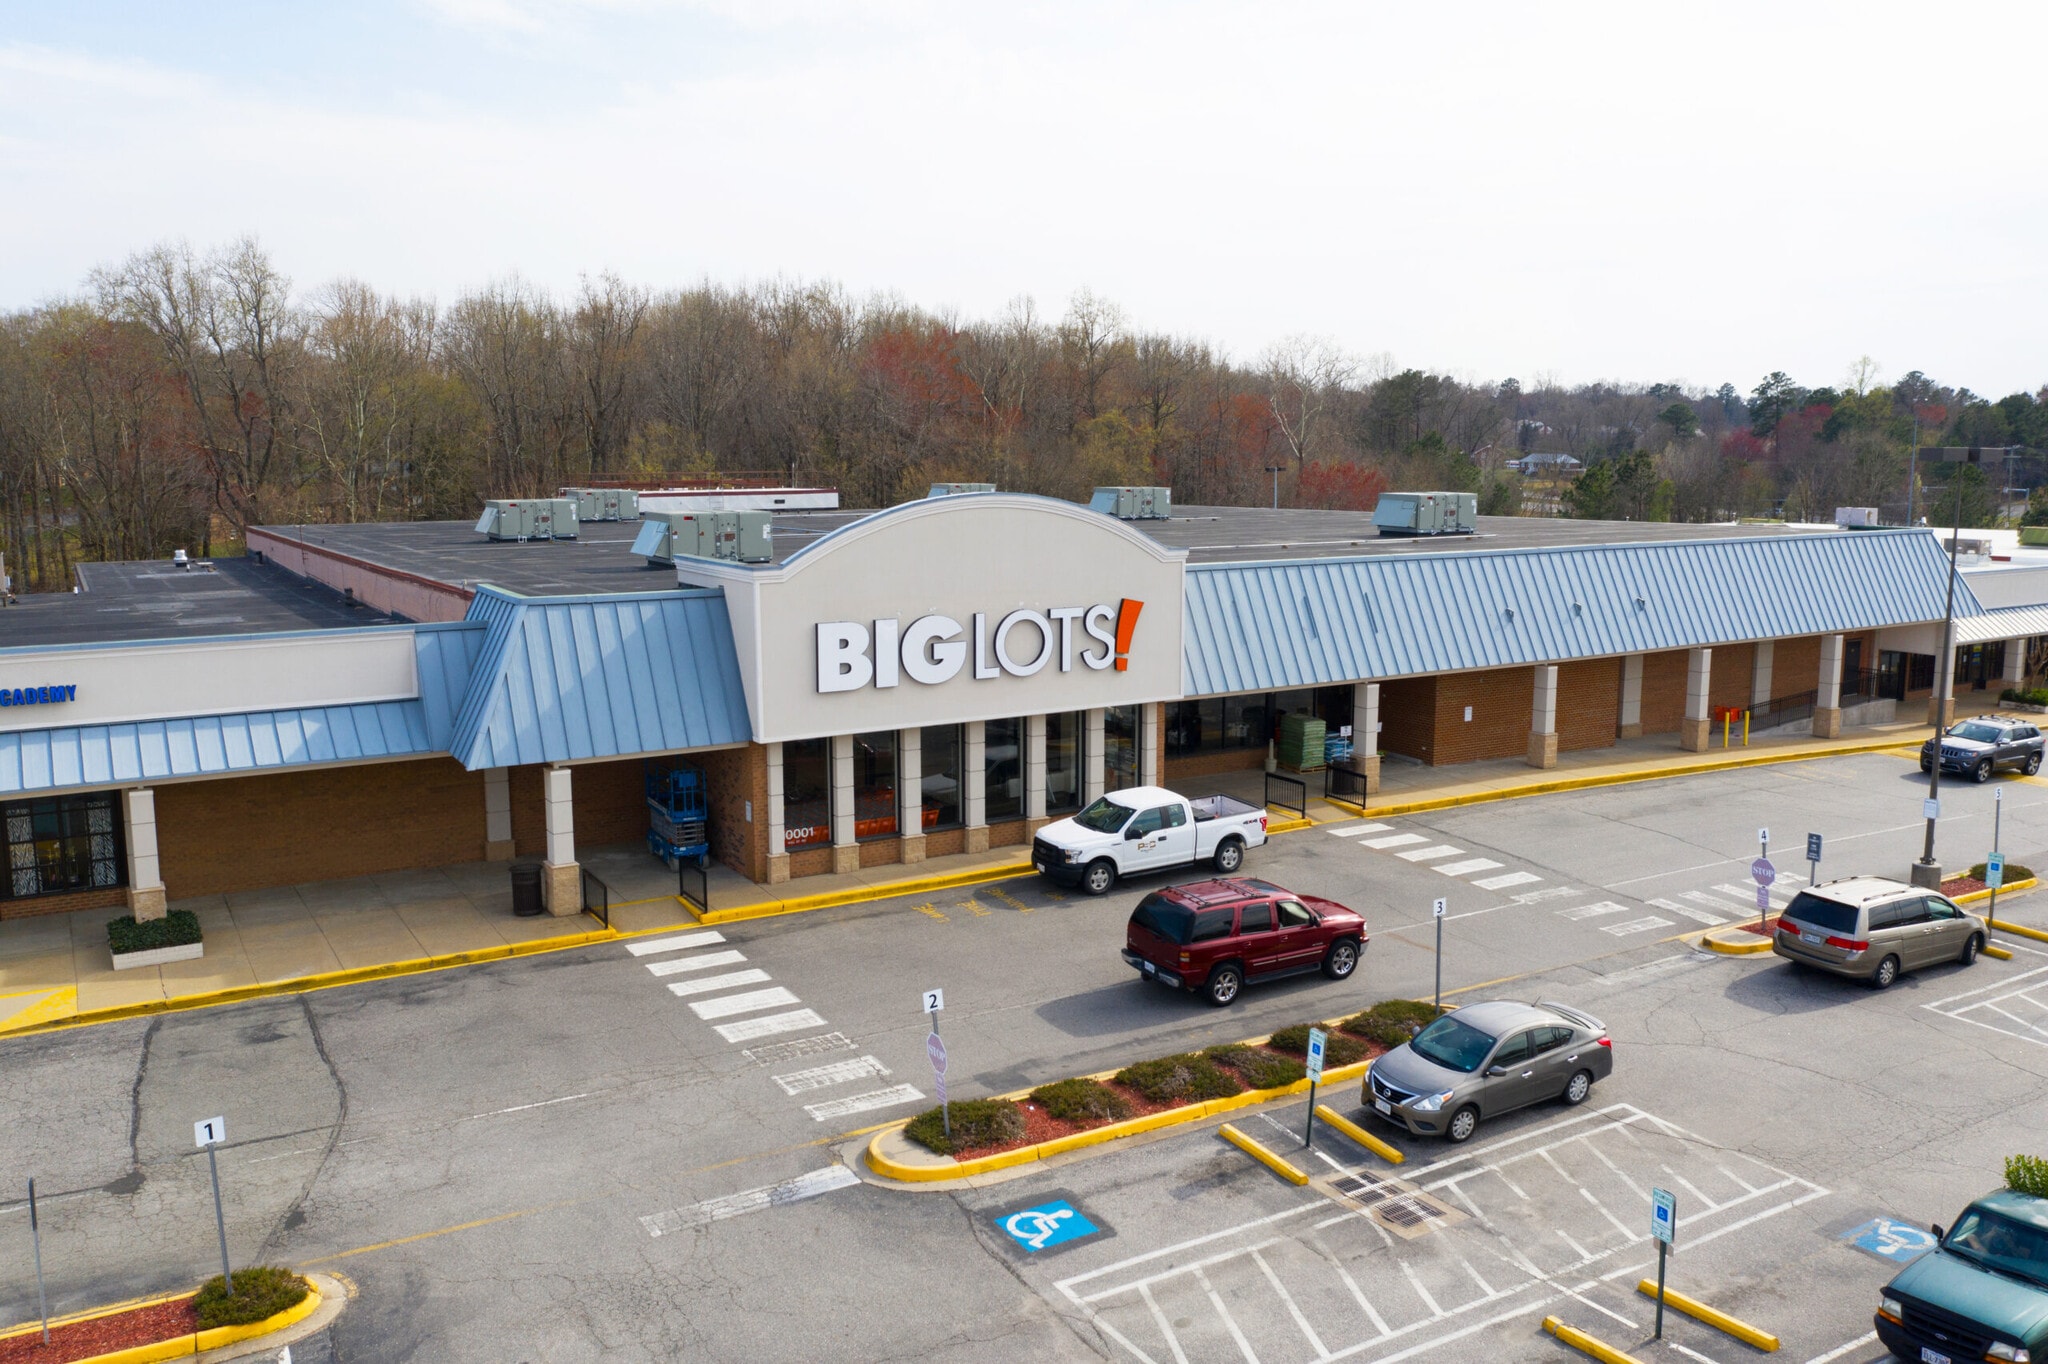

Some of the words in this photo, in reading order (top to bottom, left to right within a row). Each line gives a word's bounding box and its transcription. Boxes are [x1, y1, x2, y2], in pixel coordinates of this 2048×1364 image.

[815, 614, 967, 693] BIG
[1761, 830, 1767, 841] 4
[1752, 866, 1774, 878] STOP
[1436, 901, 1443, 914] 3
[928, 994, 938, 1009] 2
[928, 1045, 946, 1061] STOP
[204, 1123, 213, 1140] 1
